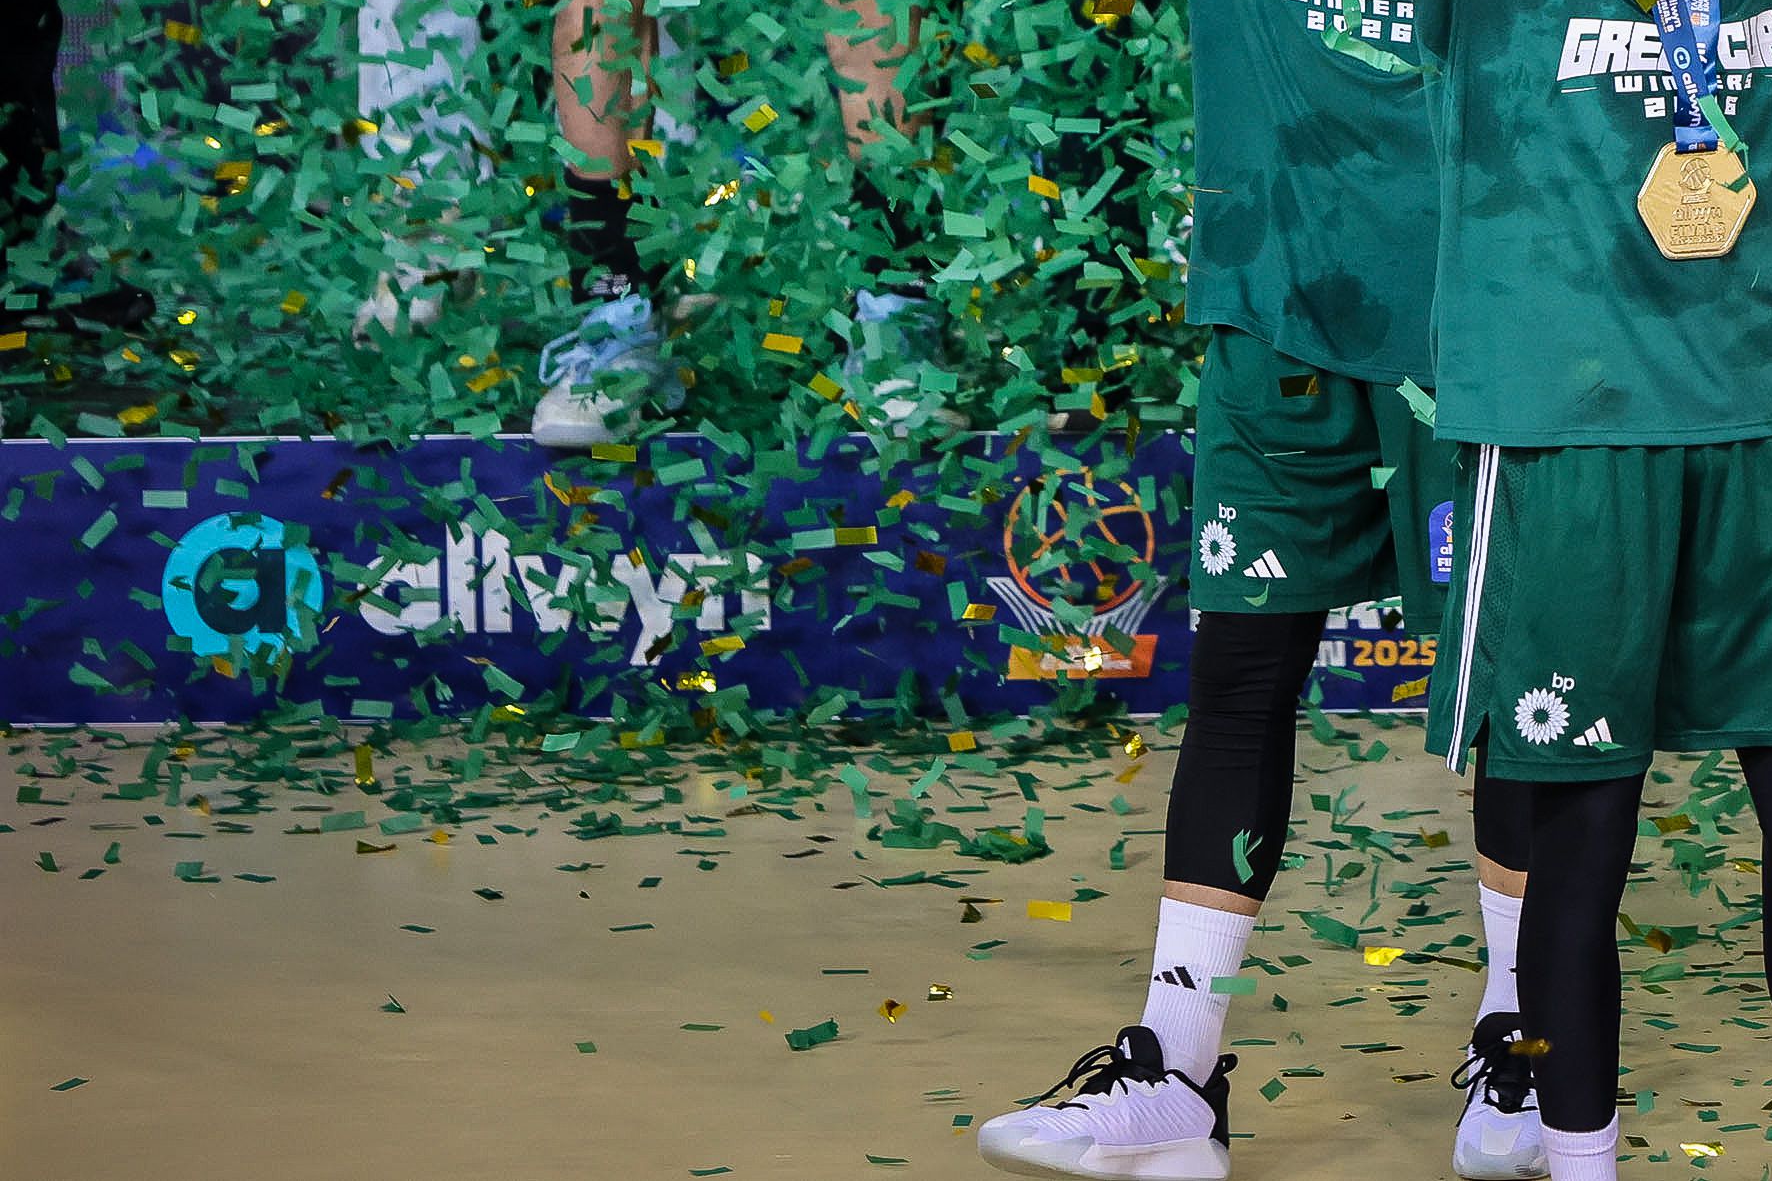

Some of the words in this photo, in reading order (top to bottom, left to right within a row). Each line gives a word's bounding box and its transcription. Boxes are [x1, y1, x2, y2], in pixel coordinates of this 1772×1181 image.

[1307, 9, 1413, 43] 2026
[1556, 17, 1672, 82] GRE
[1643, 95, 1739, 118] 26
[1218, 502, 1237, 523] bp
[1551, 672, 1575, 693] bp
